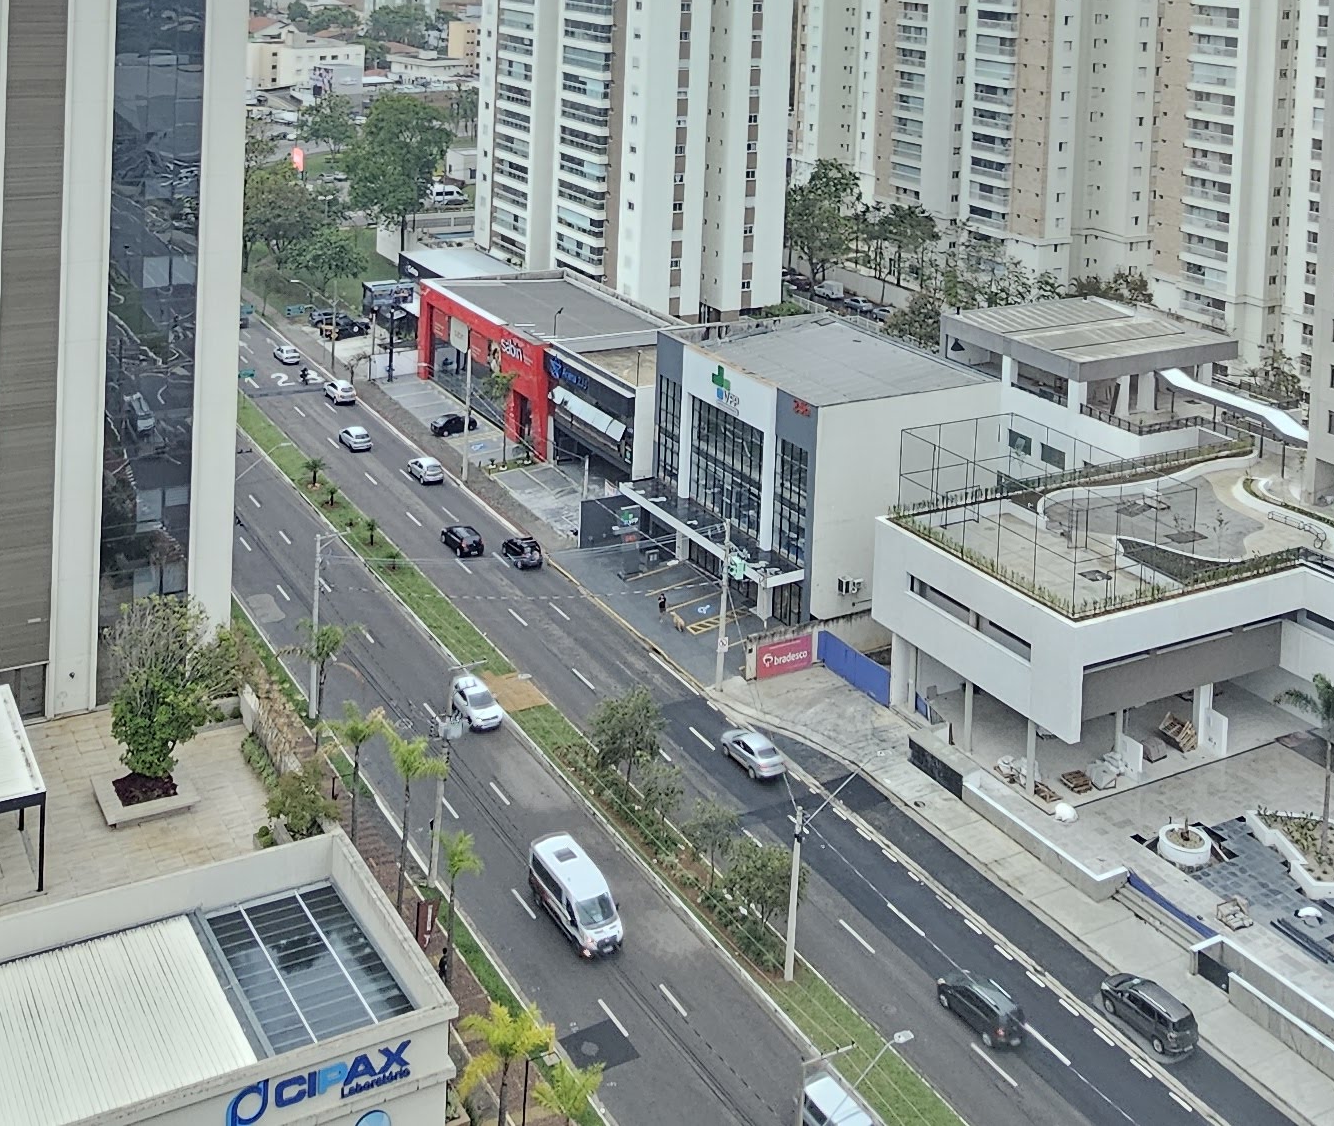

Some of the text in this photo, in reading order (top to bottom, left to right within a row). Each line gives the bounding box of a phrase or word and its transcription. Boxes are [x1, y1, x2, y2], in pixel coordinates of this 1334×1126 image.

[271, 373, 295, 386] 2
[774, 651, 808, 666] bradesco
[275, 1039, 412, 1108] CIPAX
